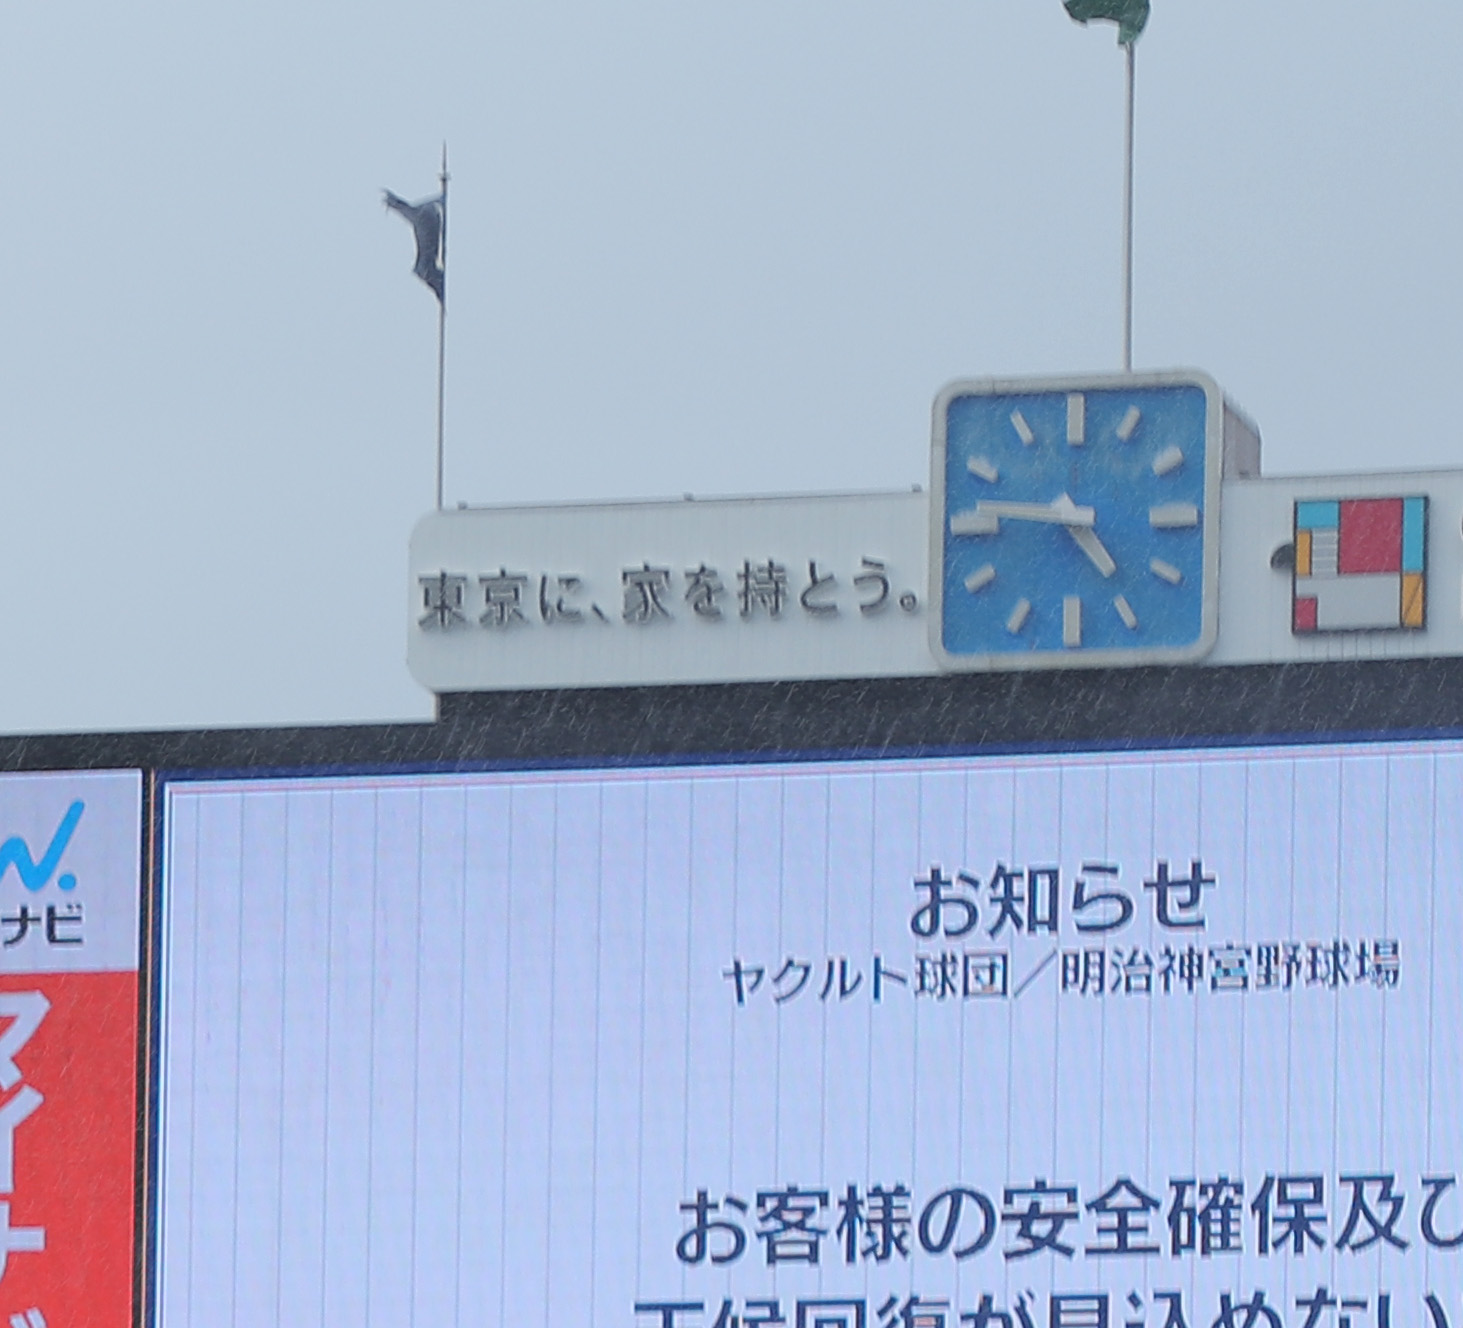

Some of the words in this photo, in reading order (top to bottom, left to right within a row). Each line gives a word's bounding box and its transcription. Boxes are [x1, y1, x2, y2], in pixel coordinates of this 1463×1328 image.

[417, 556, 926, 632] 東京に、家を持とう。
[909, 858, 1217, 935] お知らせ
[722, 938, 1403, 1005] ヤクルト球団／明治神宮野球場
